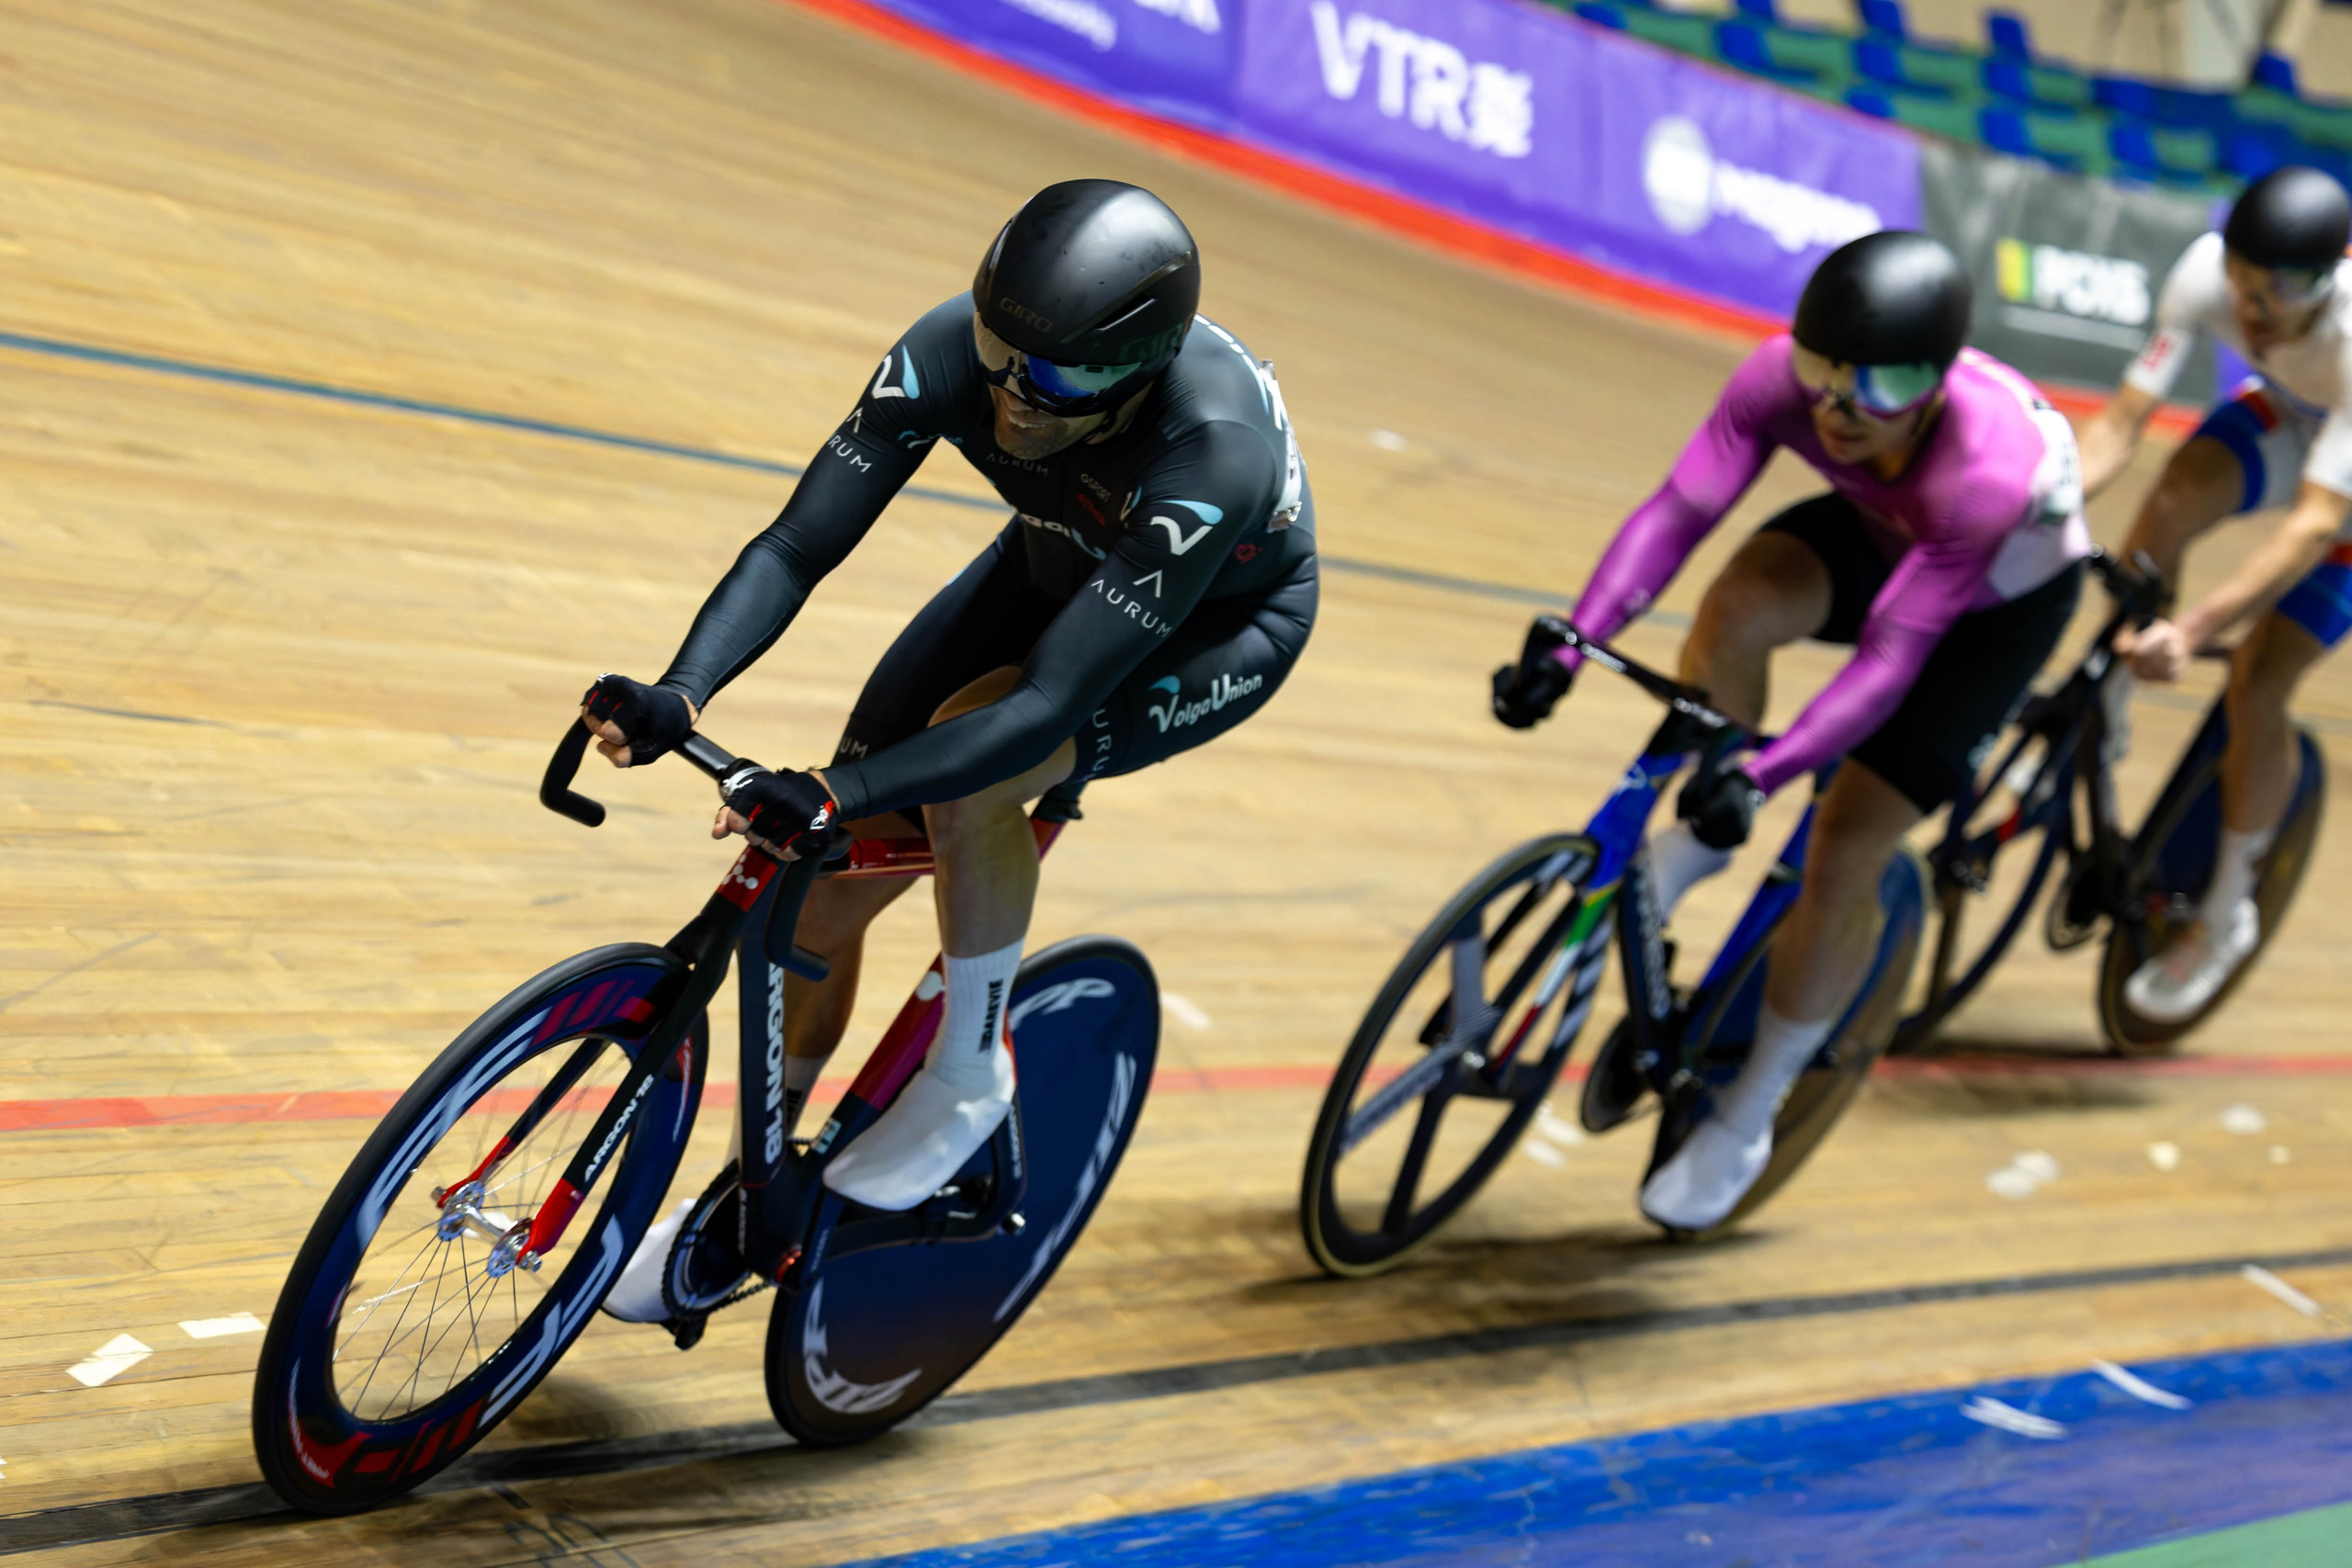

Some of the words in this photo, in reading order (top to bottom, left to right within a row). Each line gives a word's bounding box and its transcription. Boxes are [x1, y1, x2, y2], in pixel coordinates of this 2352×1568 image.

[999, 297, 1053, 333] GIRO
[828, 434, 872, 472] RUM
[1091, 579, 1171, 637] AURUM
[584, 1098, 639, 1182] ARGON
[636, 1074, 654, 1098] 18
